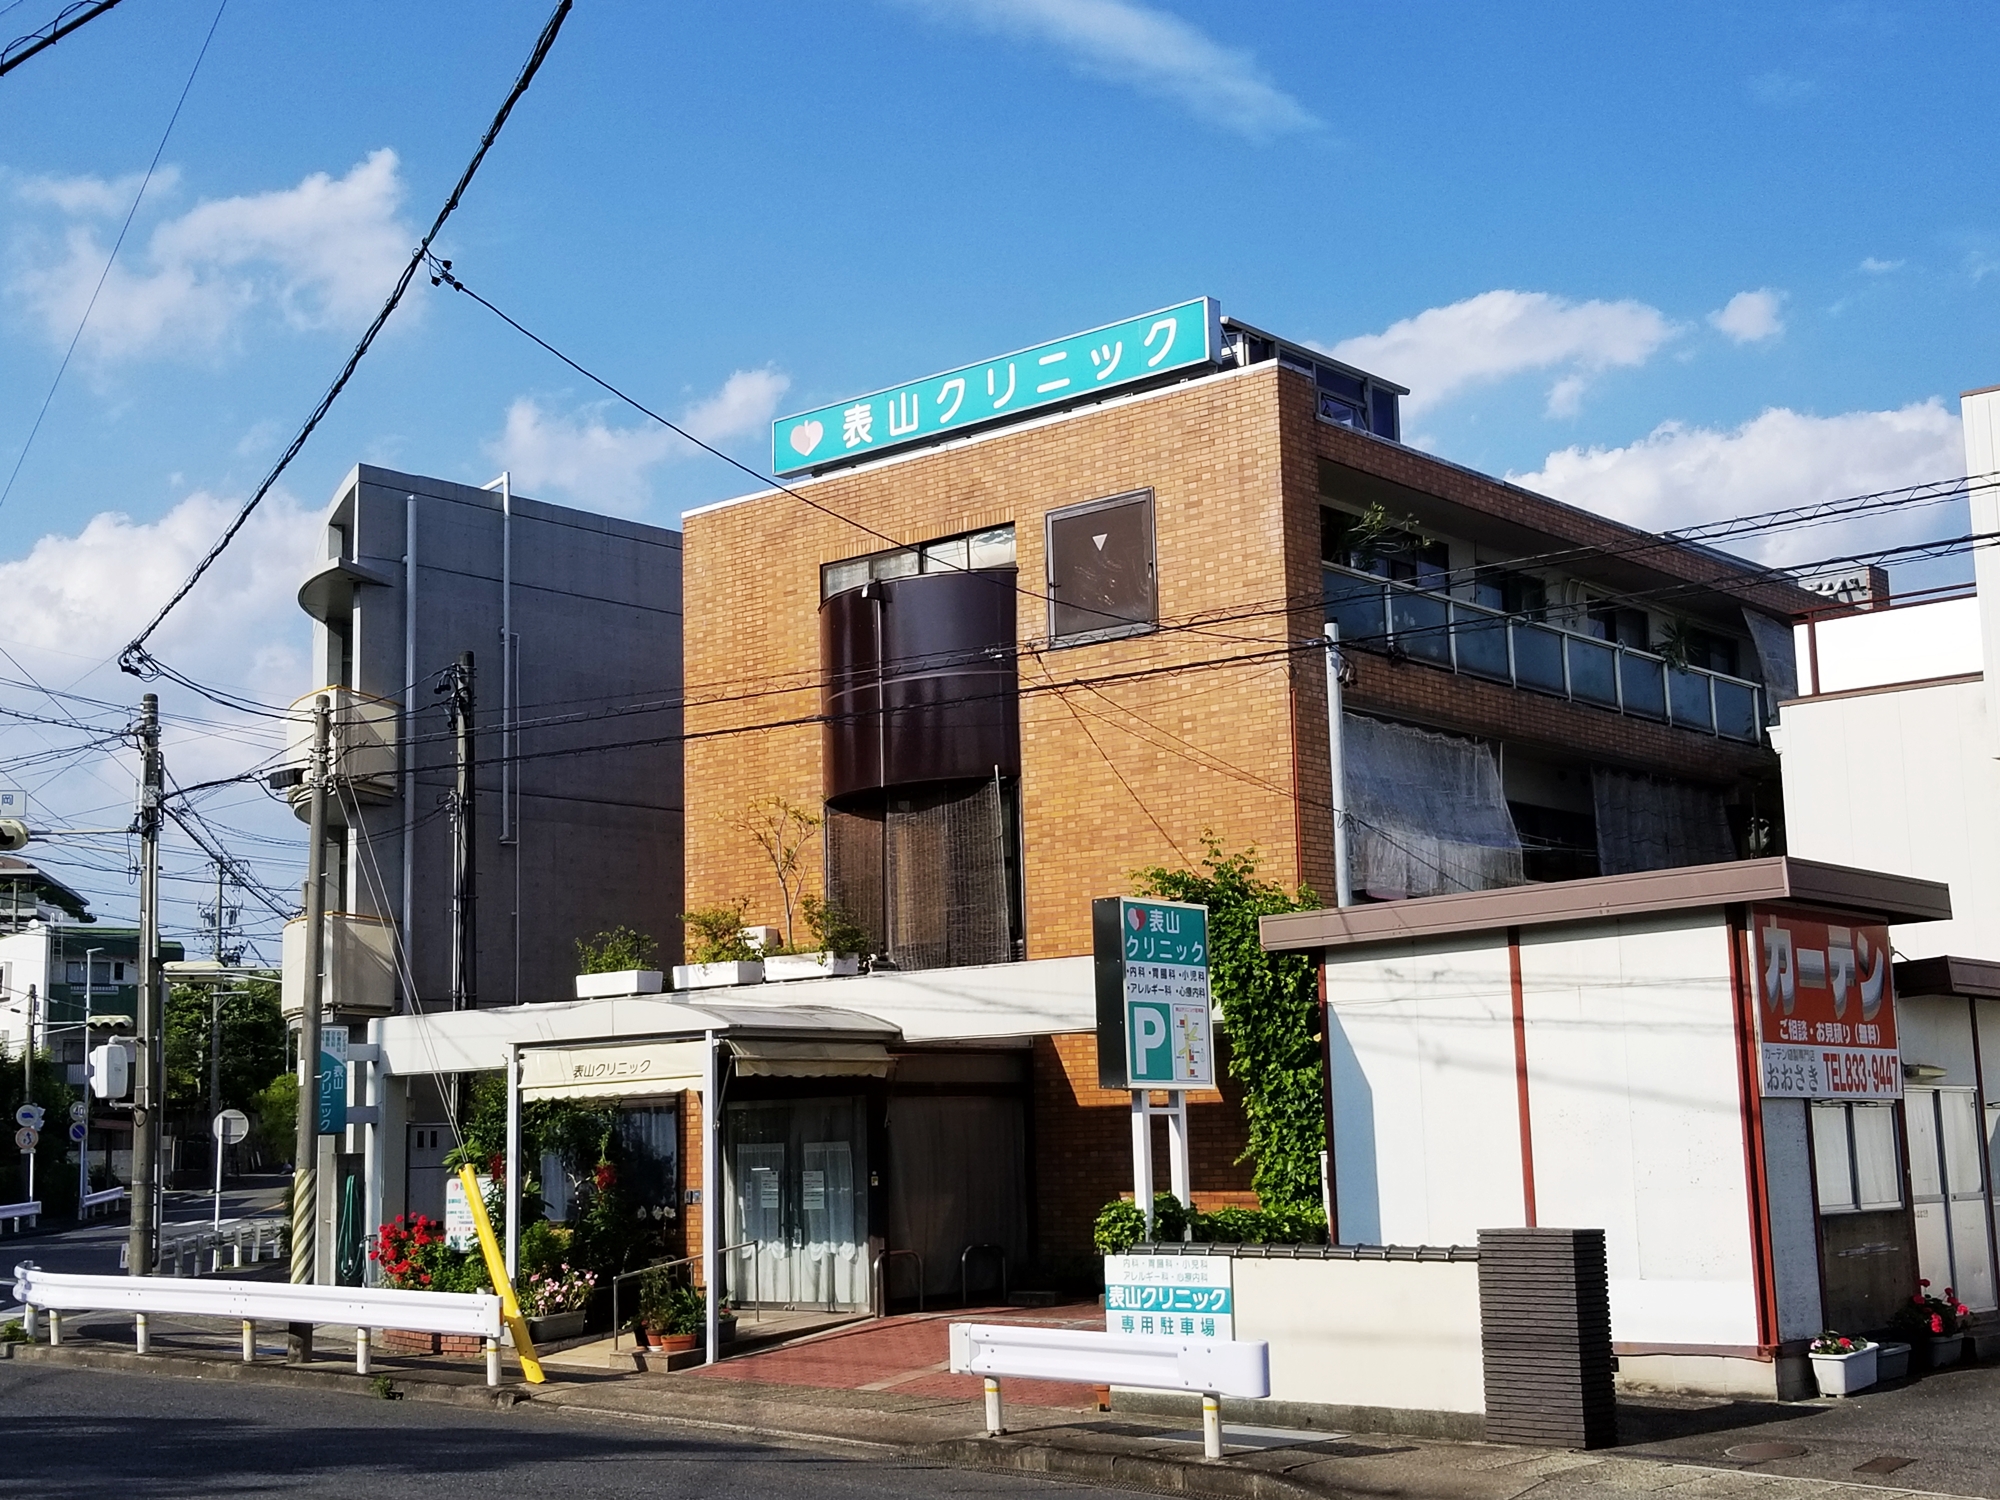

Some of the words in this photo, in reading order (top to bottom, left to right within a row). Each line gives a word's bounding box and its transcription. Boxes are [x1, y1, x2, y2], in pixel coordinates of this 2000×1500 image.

[841, 317, 1177, 449] 表山クリニック
[1149, 908, 1180, 934] 表山
[1126, 935, 1204, 963] クリニック
[1762, 914, 1885, 1022] カーテン
[1133, 1007, 1167, 1075] P
[333, 1065, 344, 1090] 表山
[573, 1060, 651, 1078] 表山クリニック
[1767, 1063, 1819, 1092] おおさき
[321, 1070, 332, 1131] クリニック
[1108, 1285, 1226, 1311] 表山クリニック
[1121, 1315, 1215, 1337] 専用駐車場
